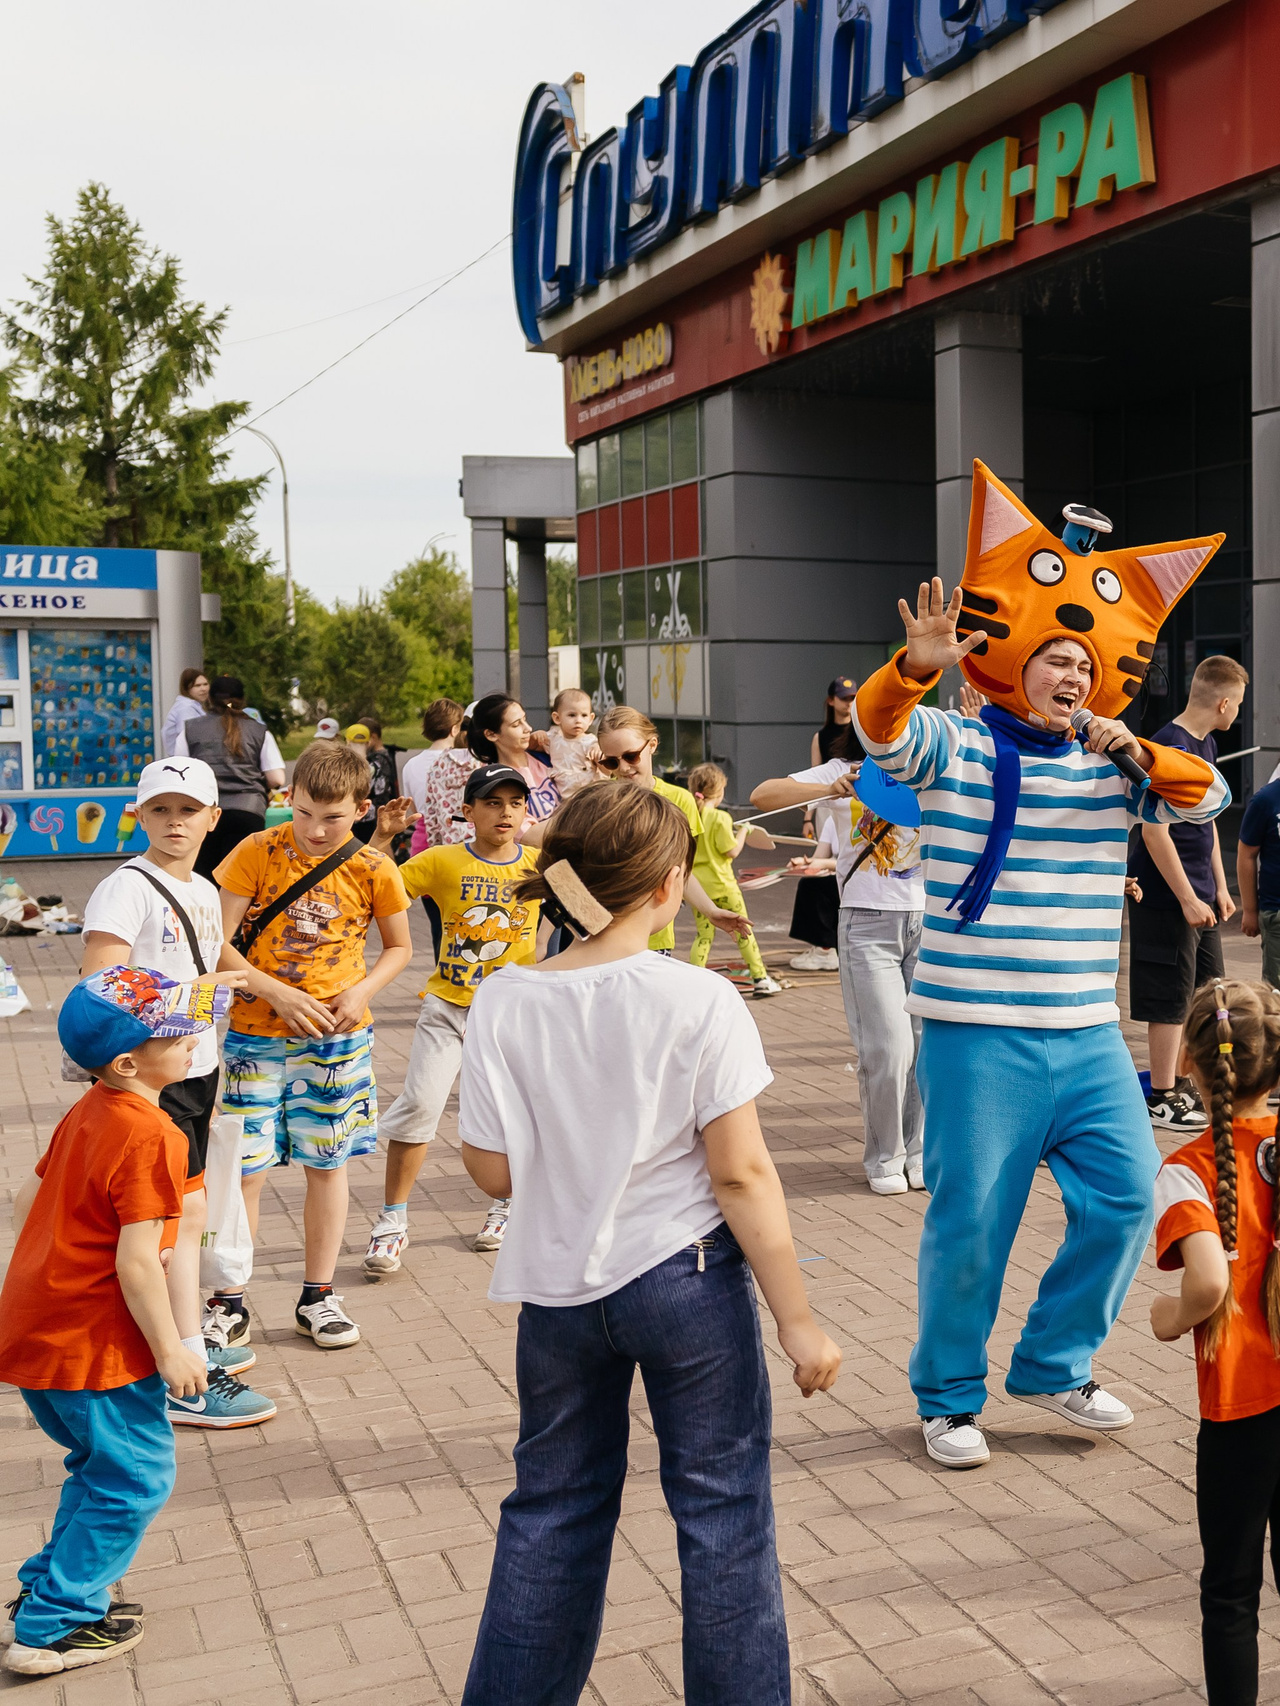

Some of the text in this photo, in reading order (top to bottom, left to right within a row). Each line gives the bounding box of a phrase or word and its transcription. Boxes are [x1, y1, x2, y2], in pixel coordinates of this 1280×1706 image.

[790, 72, 1155, 330] МАРИЯ-РА
[461, 875, 500, 884] FOOTBALL
[460, 883, 524, 905] FIRS
[439, 961, 503, 987] TEA
